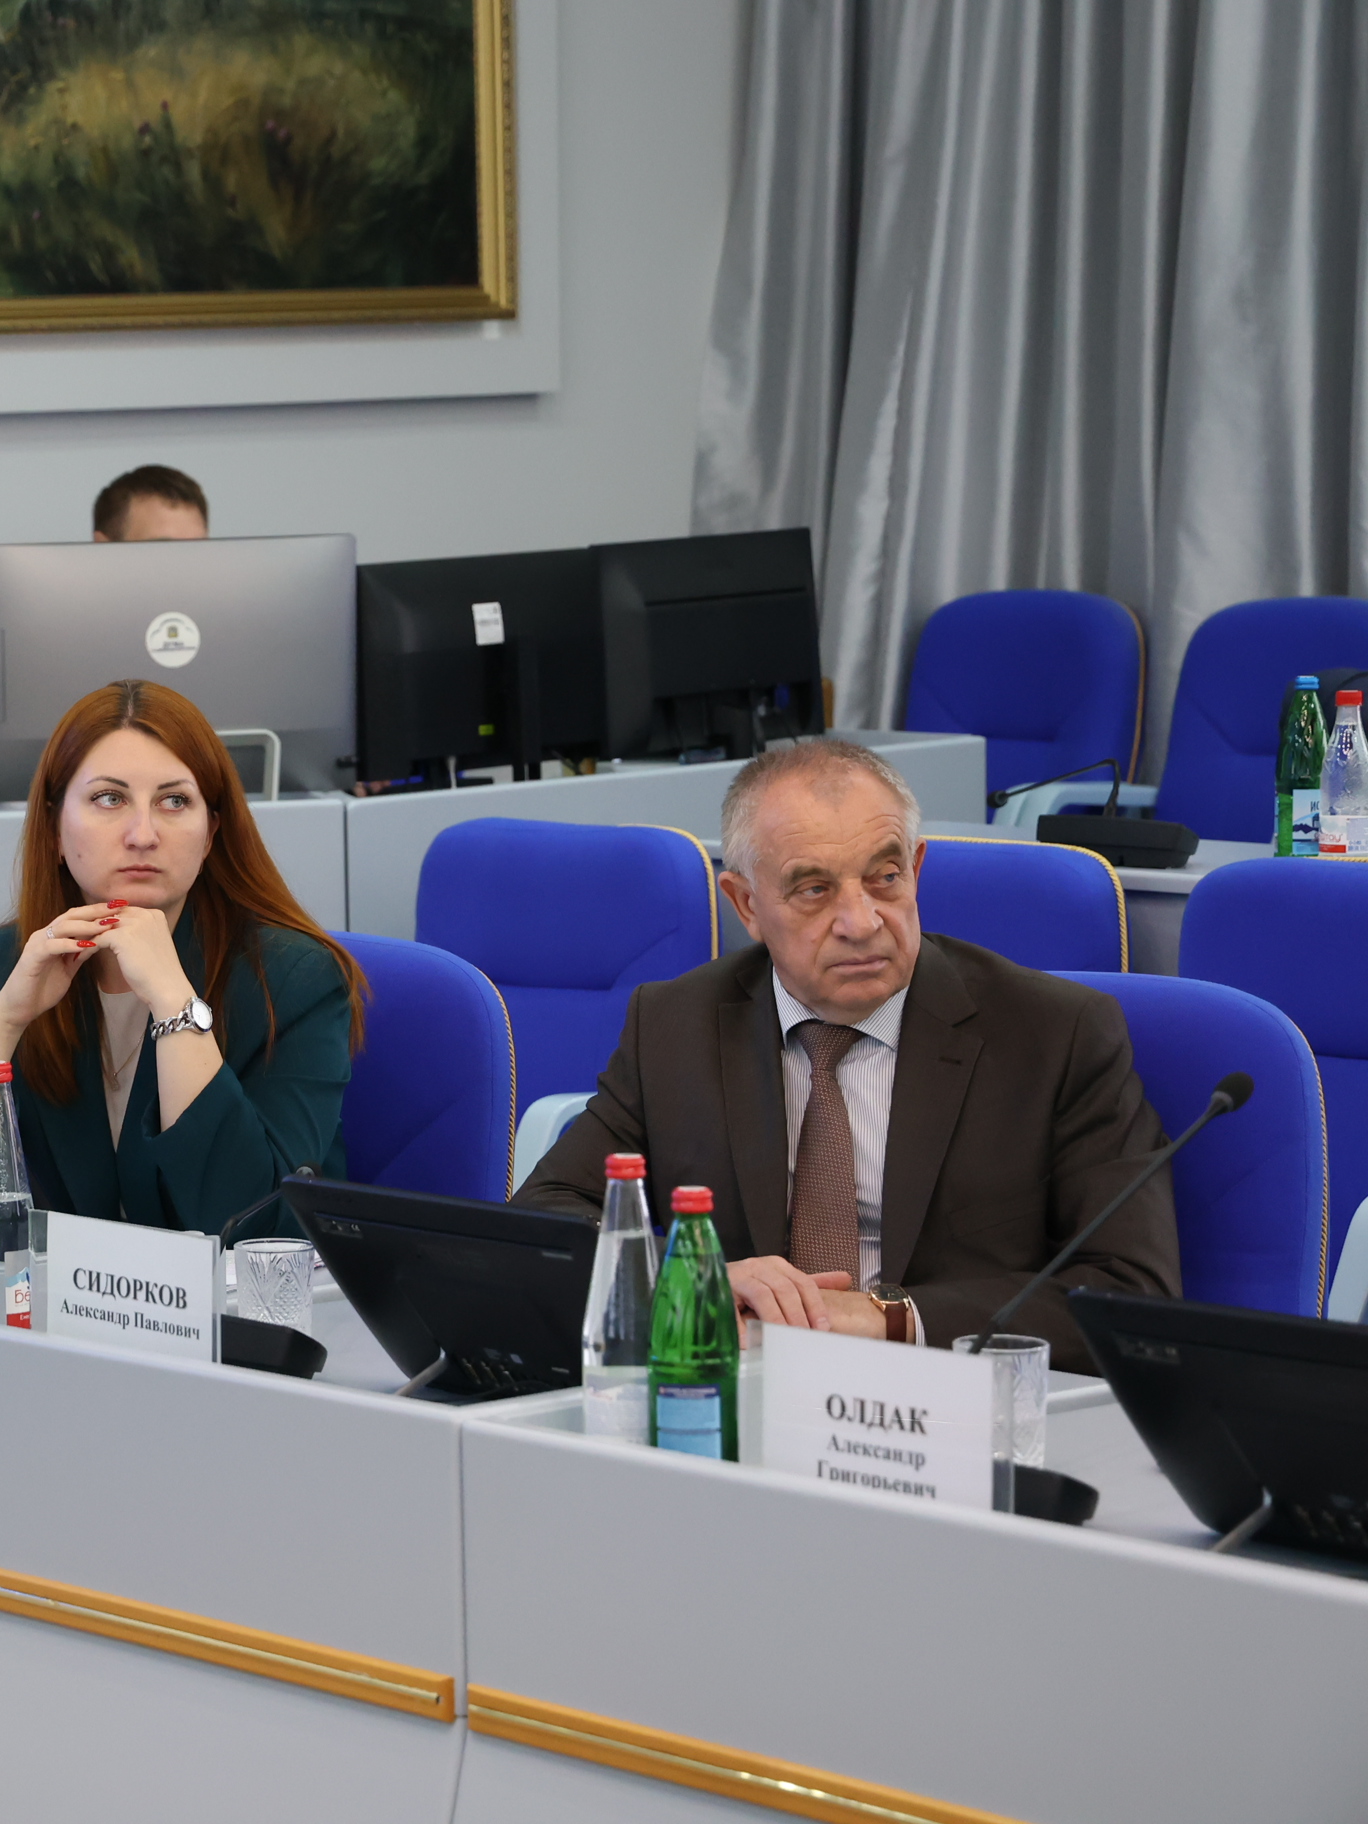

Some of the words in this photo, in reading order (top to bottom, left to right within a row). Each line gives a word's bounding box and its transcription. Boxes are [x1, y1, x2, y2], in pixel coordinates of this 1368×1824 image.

[71, 1266, 188, 1310] СИДОРКОВ
[60, 1298, 130, 1330] Александр
[133, 1312, 201, 1341] Павлович
[825, 1393, 930, 1435] ОЛДАК
[826, 1433, 927, 1472] Александр
[816, 1458, 937, 1499] Григорьевич
